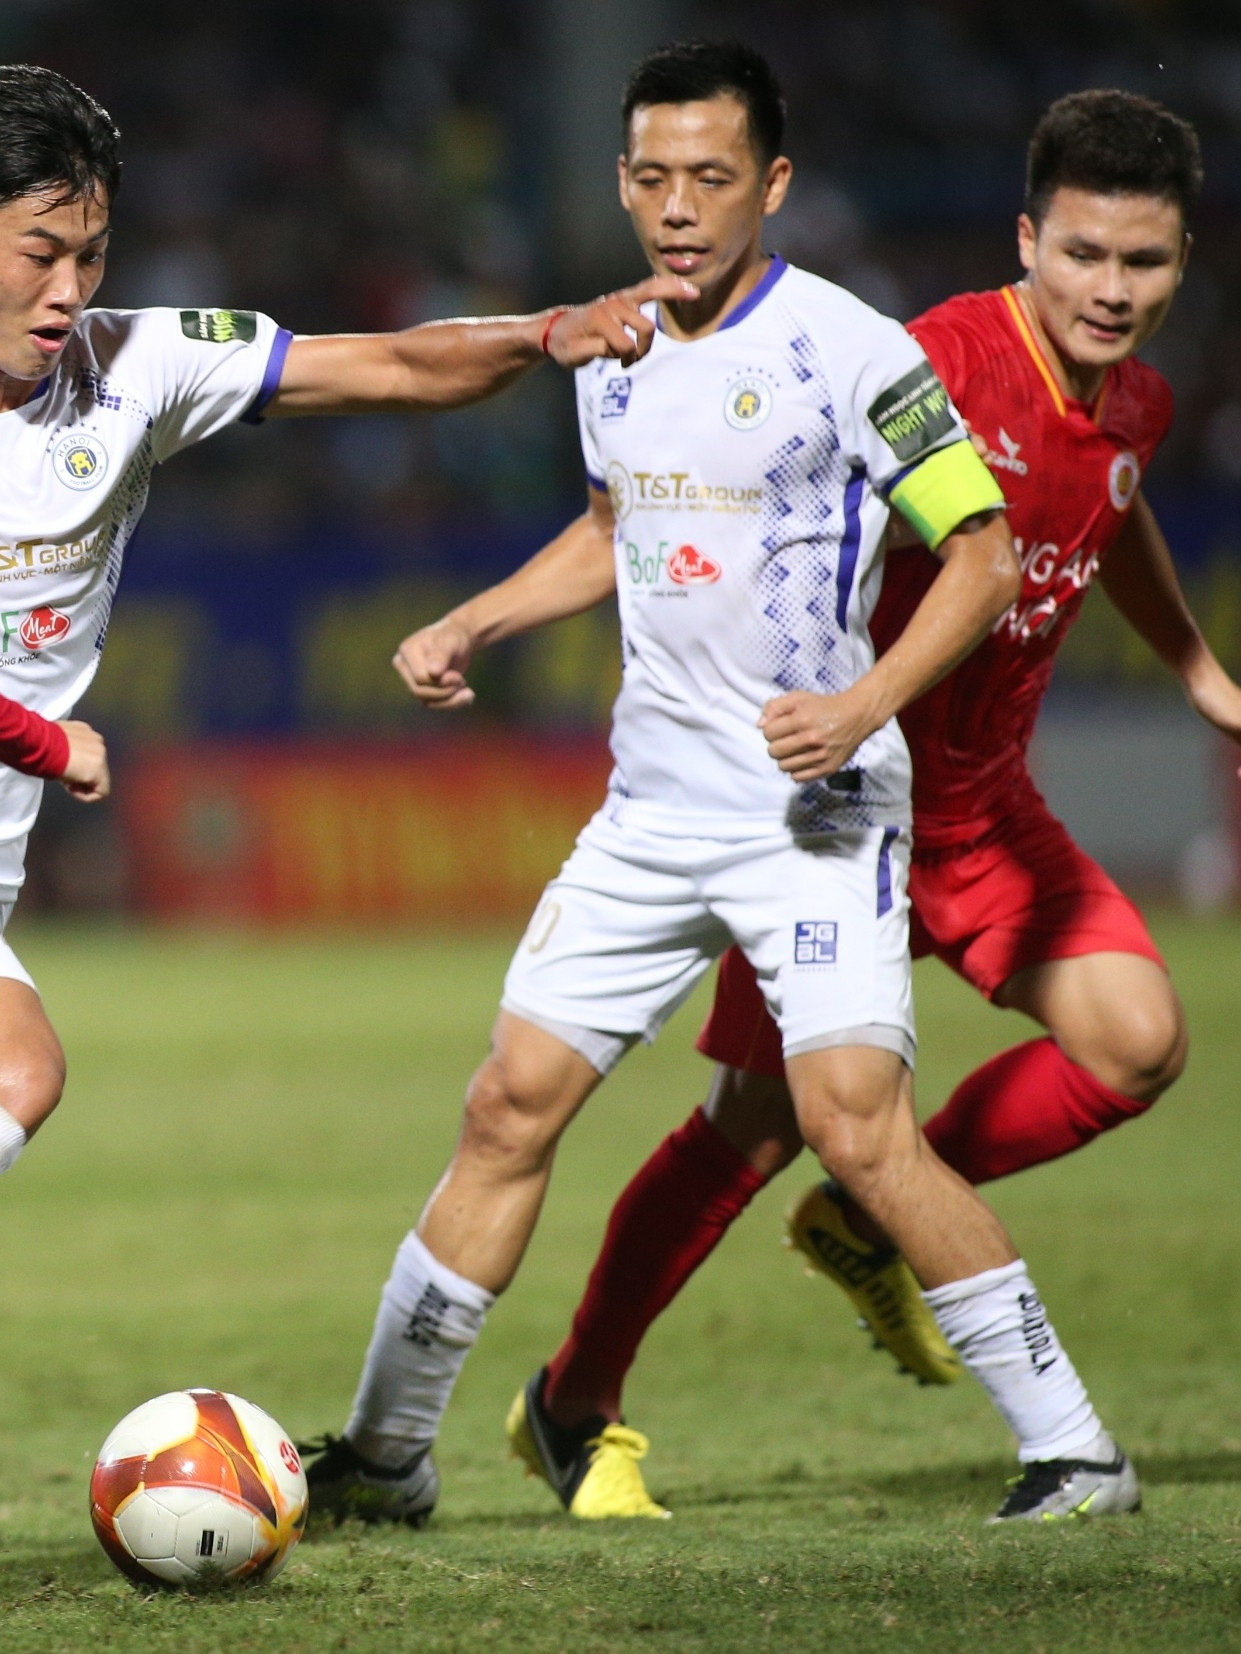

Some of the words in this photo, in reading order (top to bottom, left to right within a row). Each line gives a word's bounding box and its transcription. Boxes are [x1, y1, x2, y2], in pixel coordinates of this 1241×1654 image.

[881, 402, 928, 444] NIGHT
[922, 386, 948, 419] WO
[57, 436, 91, 458] HANOI
[26, 613, 59, 640] Meat
